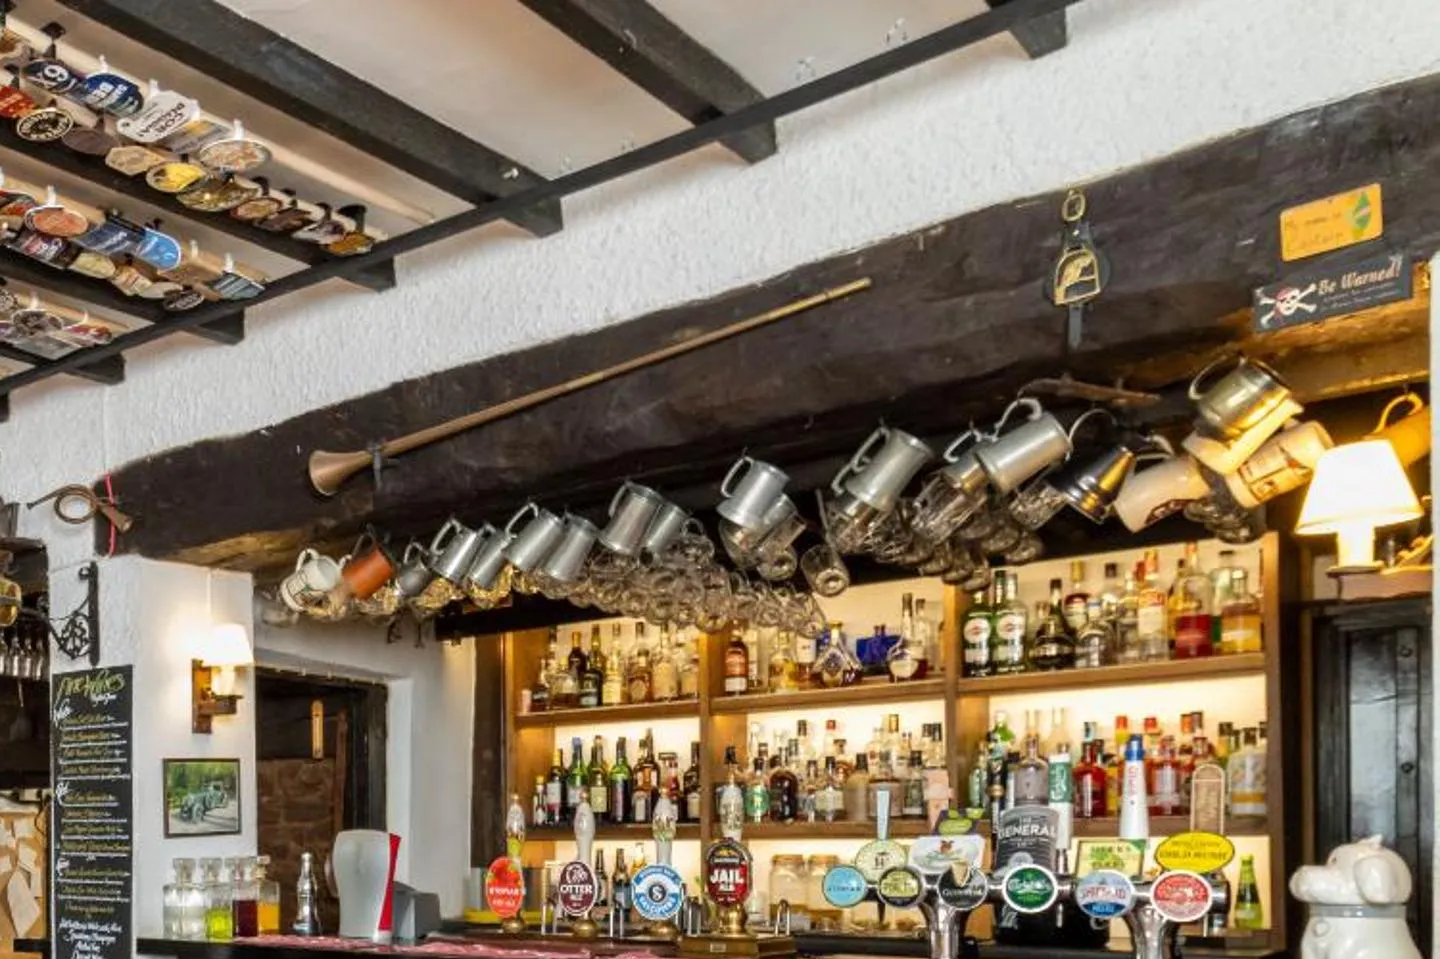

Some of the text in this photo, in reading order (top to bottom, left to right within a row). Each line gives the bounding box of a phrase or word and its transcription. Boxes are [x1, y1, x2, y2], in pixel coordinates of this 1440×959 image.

[998, 823, 1058, 840] GENERAL
[709, 868, 745, 884] JAIL
[559, 884, 593, 894] OTTER
